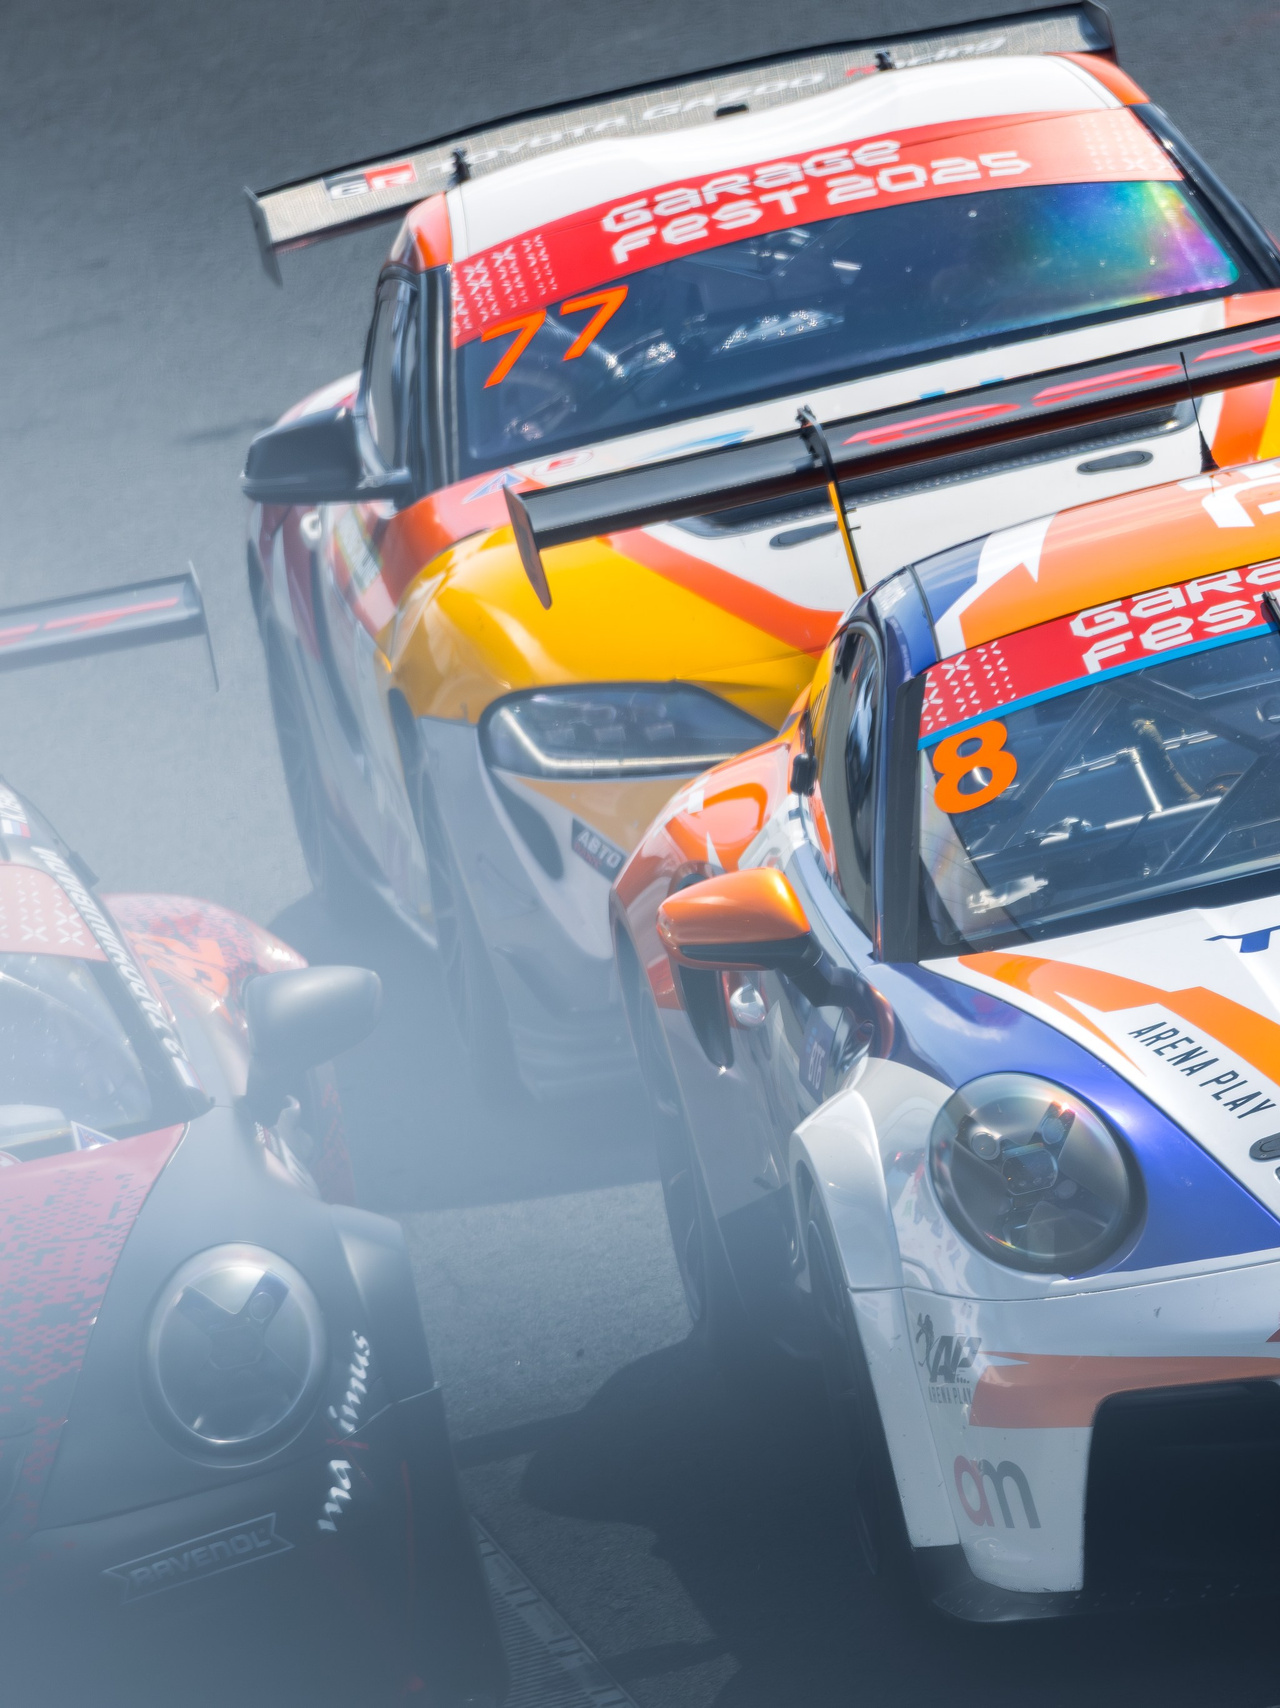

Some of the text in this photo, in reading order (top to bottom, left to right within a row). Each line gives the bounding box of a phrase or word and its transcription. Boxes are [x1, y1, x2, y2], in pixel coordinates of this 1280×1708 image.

[826, 150, 1032, 205] 2025
[481, 285, 629, 389] 77
[932, 720, 1018, 814] 8
[1127, 1021, 1277, 1120] ARENA PLAY
[129, 1529, 272, 1588] RAVENOL
